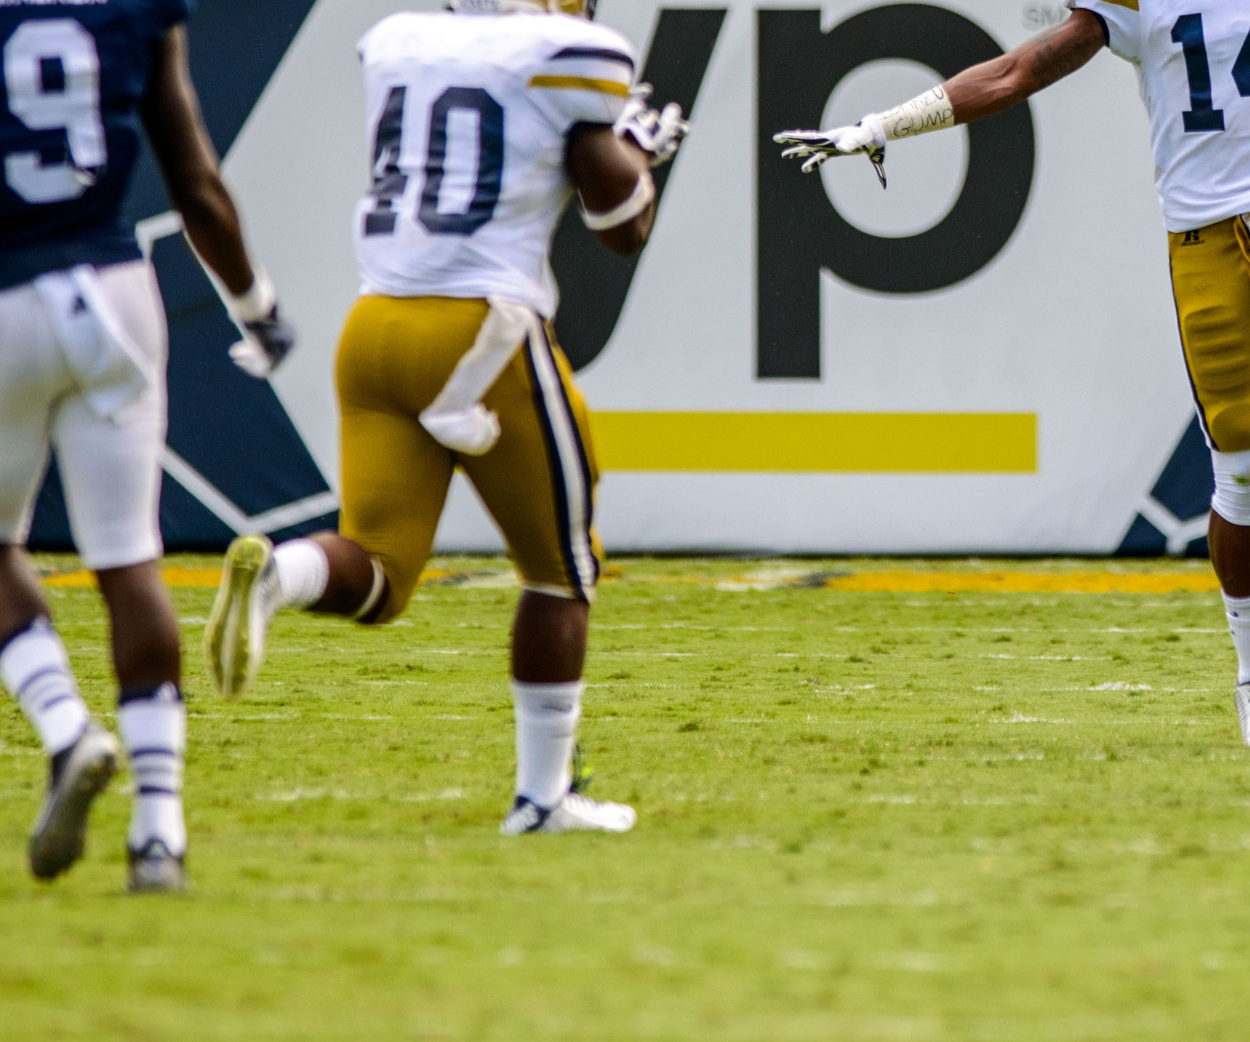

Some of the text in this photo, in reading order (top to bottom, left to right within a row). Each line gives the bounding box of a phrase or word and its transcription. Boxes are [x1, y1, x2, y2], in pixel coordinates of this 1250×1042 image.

[3, 18, 107, 203] 9
[364, 85, 505, 238] 40
[893, 108, 954, 137] GUMP
